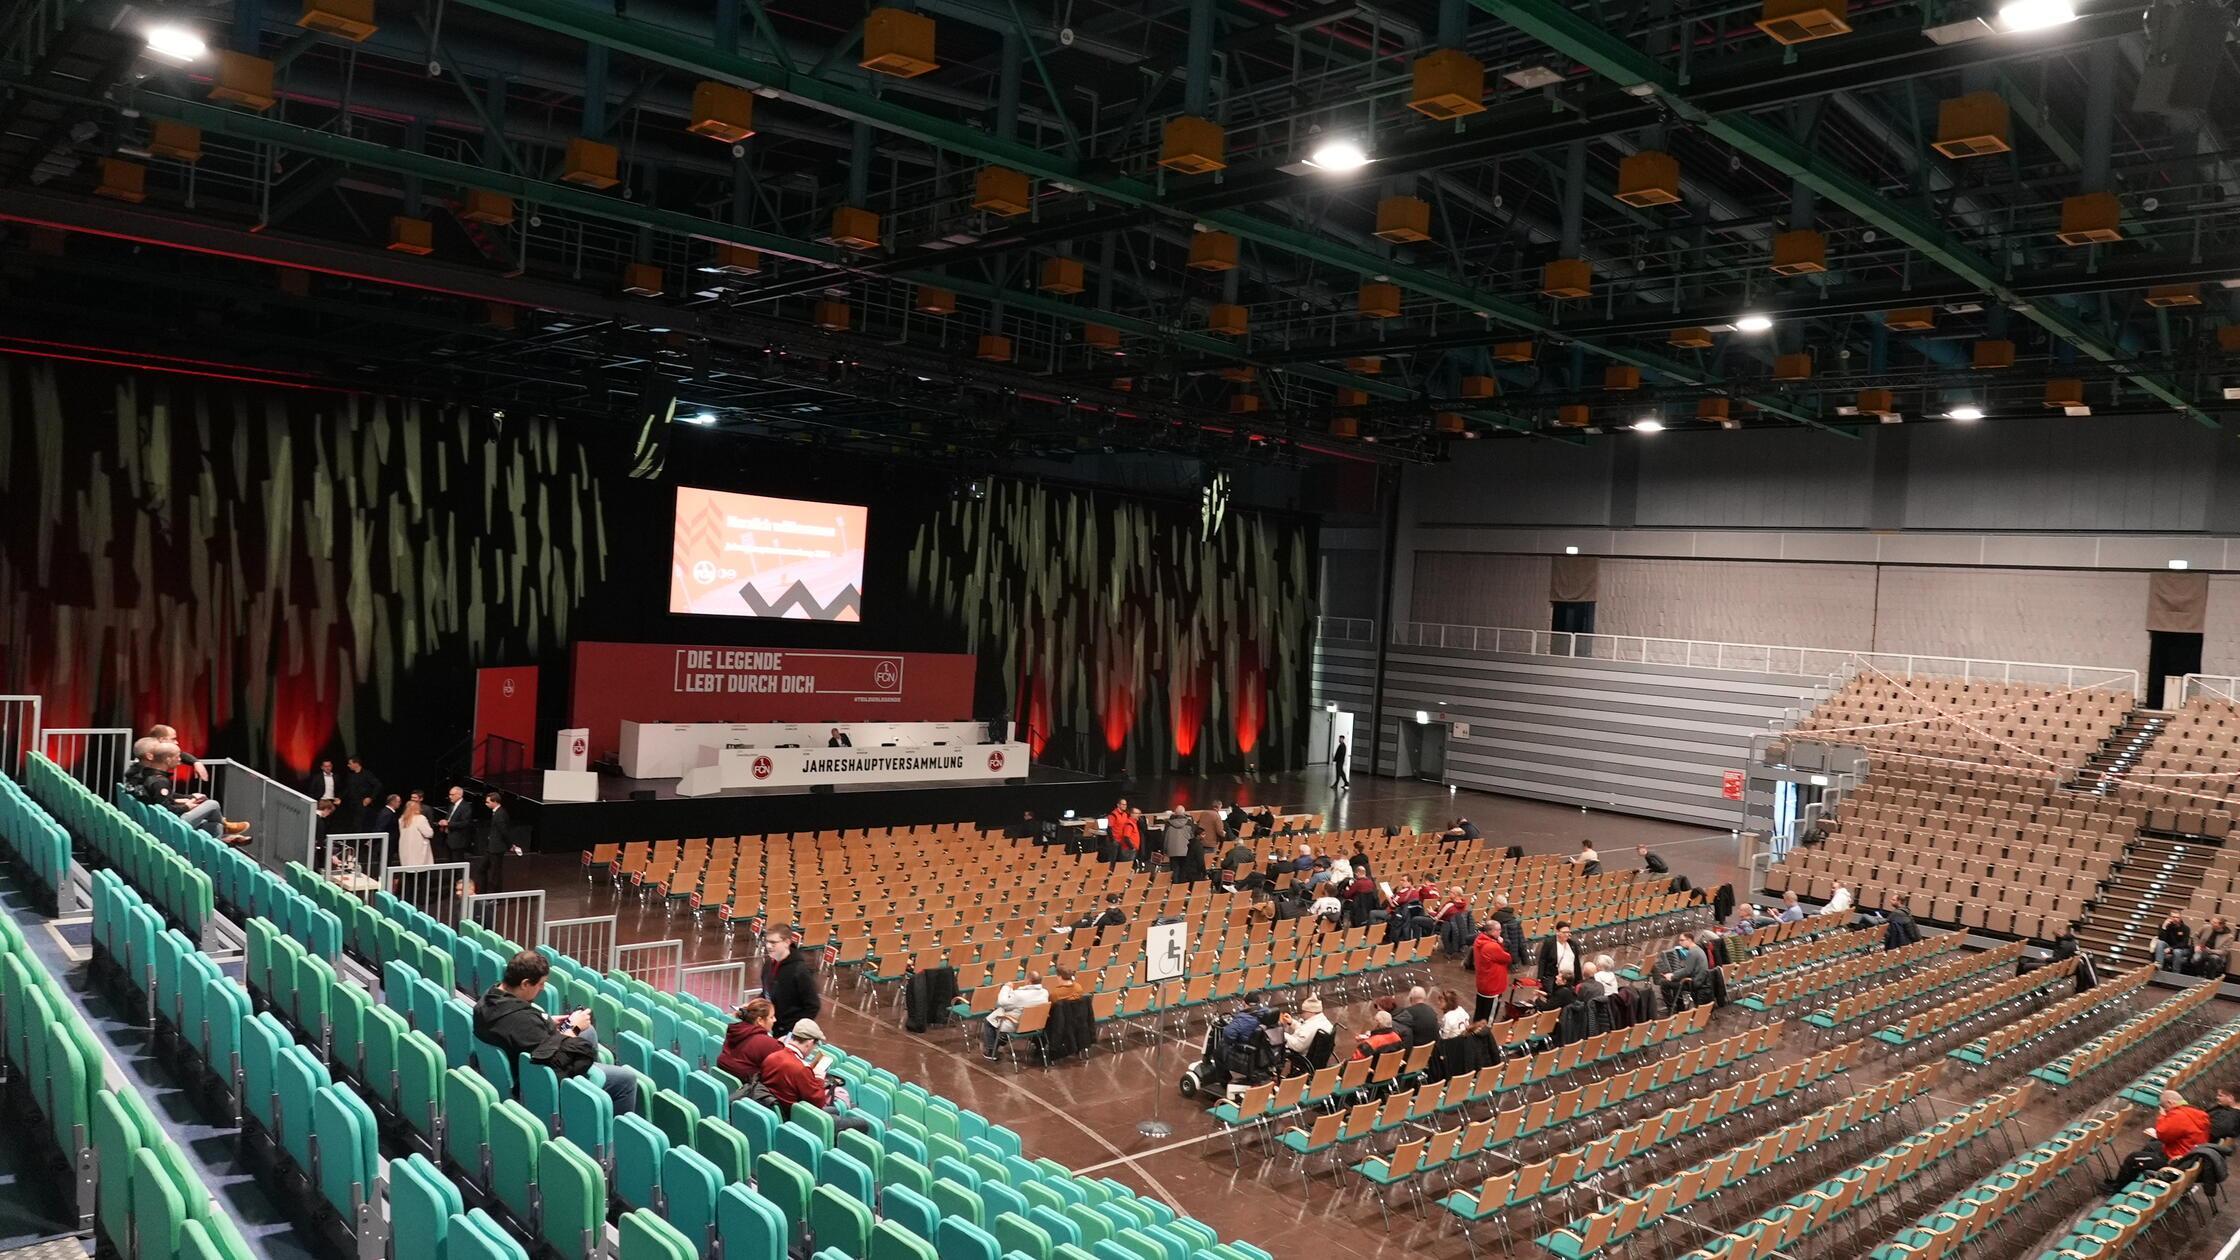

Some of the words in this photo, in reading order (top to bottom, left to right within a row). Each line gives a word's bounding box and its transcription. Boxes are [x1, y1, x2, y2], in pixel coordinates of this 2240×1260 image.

[687, 649, 713, 669] DIE
[716, 650, 783, 671] LEGENDE
[685, 673, 725, 692] LEBT
[727, 674, 778, 693] DURCH
[781, 675, 815, 693] DICH
[802, 756, 963, 773] JAHRESHAUPTVERSAMMLUNG
